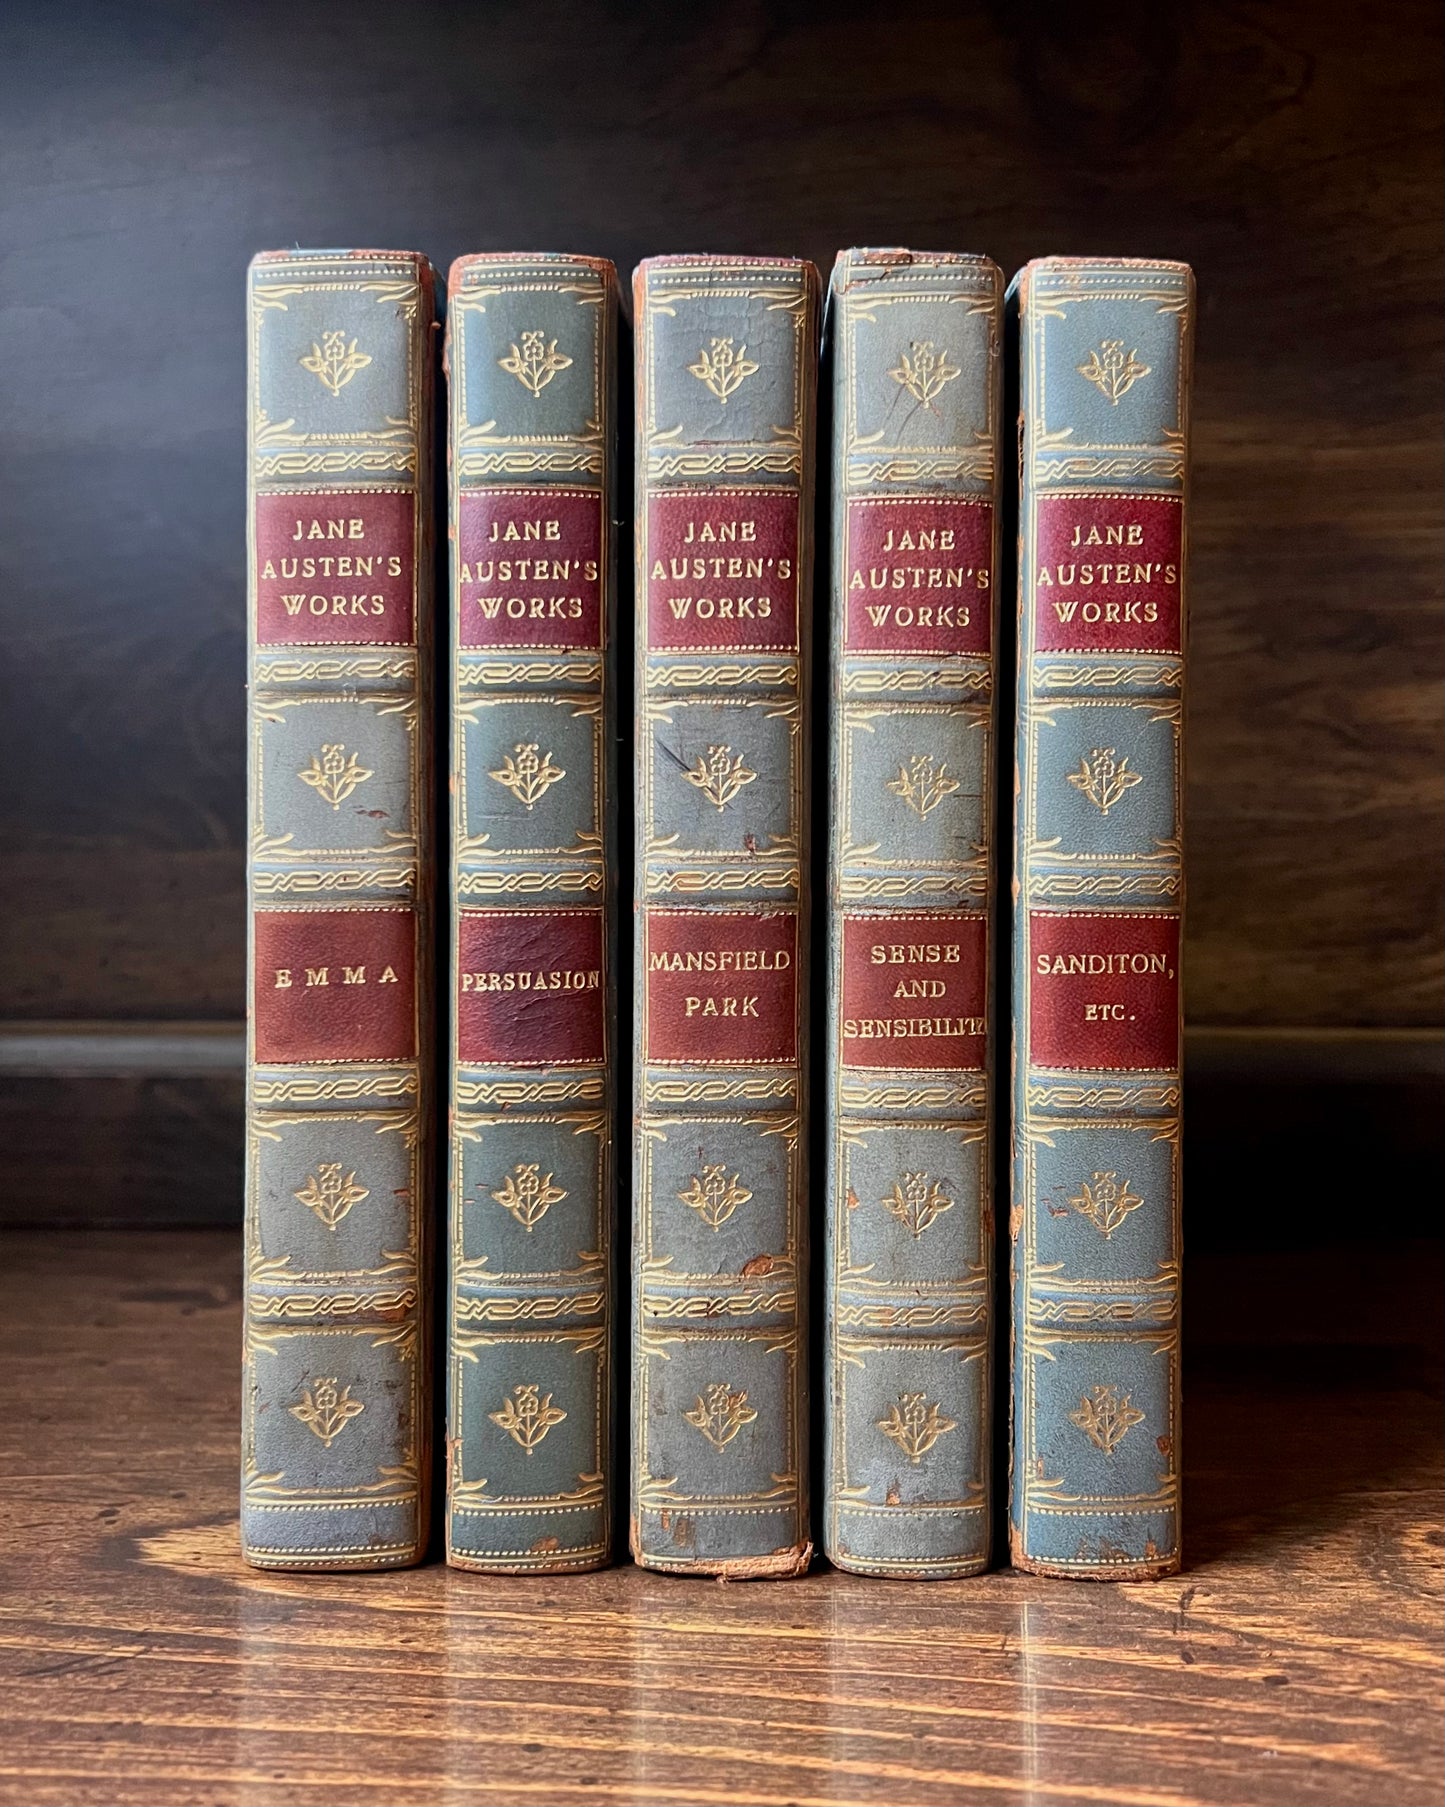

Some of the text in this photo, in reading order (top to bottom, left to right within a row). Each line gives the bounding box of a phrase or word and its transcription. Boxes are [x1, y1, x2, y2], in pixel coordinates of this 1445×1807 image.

[292, 519, 365, 541] JANE
[488, 520, 561, 542] JANE
[684, 521, 757, 544] JANE
[882, 529, 956, 551] JANE
[1070, 524, 1143, 547] JANE
[261, 556, 402, 580] AUSTEN'S
[460, 560, 598, 583] AUSTEN'S
[651, 558, 791, 580] AUSTEN'S
[849, 567, 989, 589] AUSTEN'S
[1037, 563, 1177, 587] AUSTEN'S
[280, 595, 385, 616] WORKS
[477, 597, 583, 619] WORKS
[668, 597, 772, 620] WORKS
[865, 605, 970, 628] WORKS
[1052, 601, 1159, 624] WORKS
[649, 950, 790, 972] MANSFIELD
[870, 944, 960, 965] SENSE
[1036, 953, 1175, 980] SANDITON,
[461, 970, 600, 993] PERSUASION
[893, 979, 947, 999] AND
[684, 996, 760, 1018] PARK
[1084, 1003, 1136, 1022] ETC.
